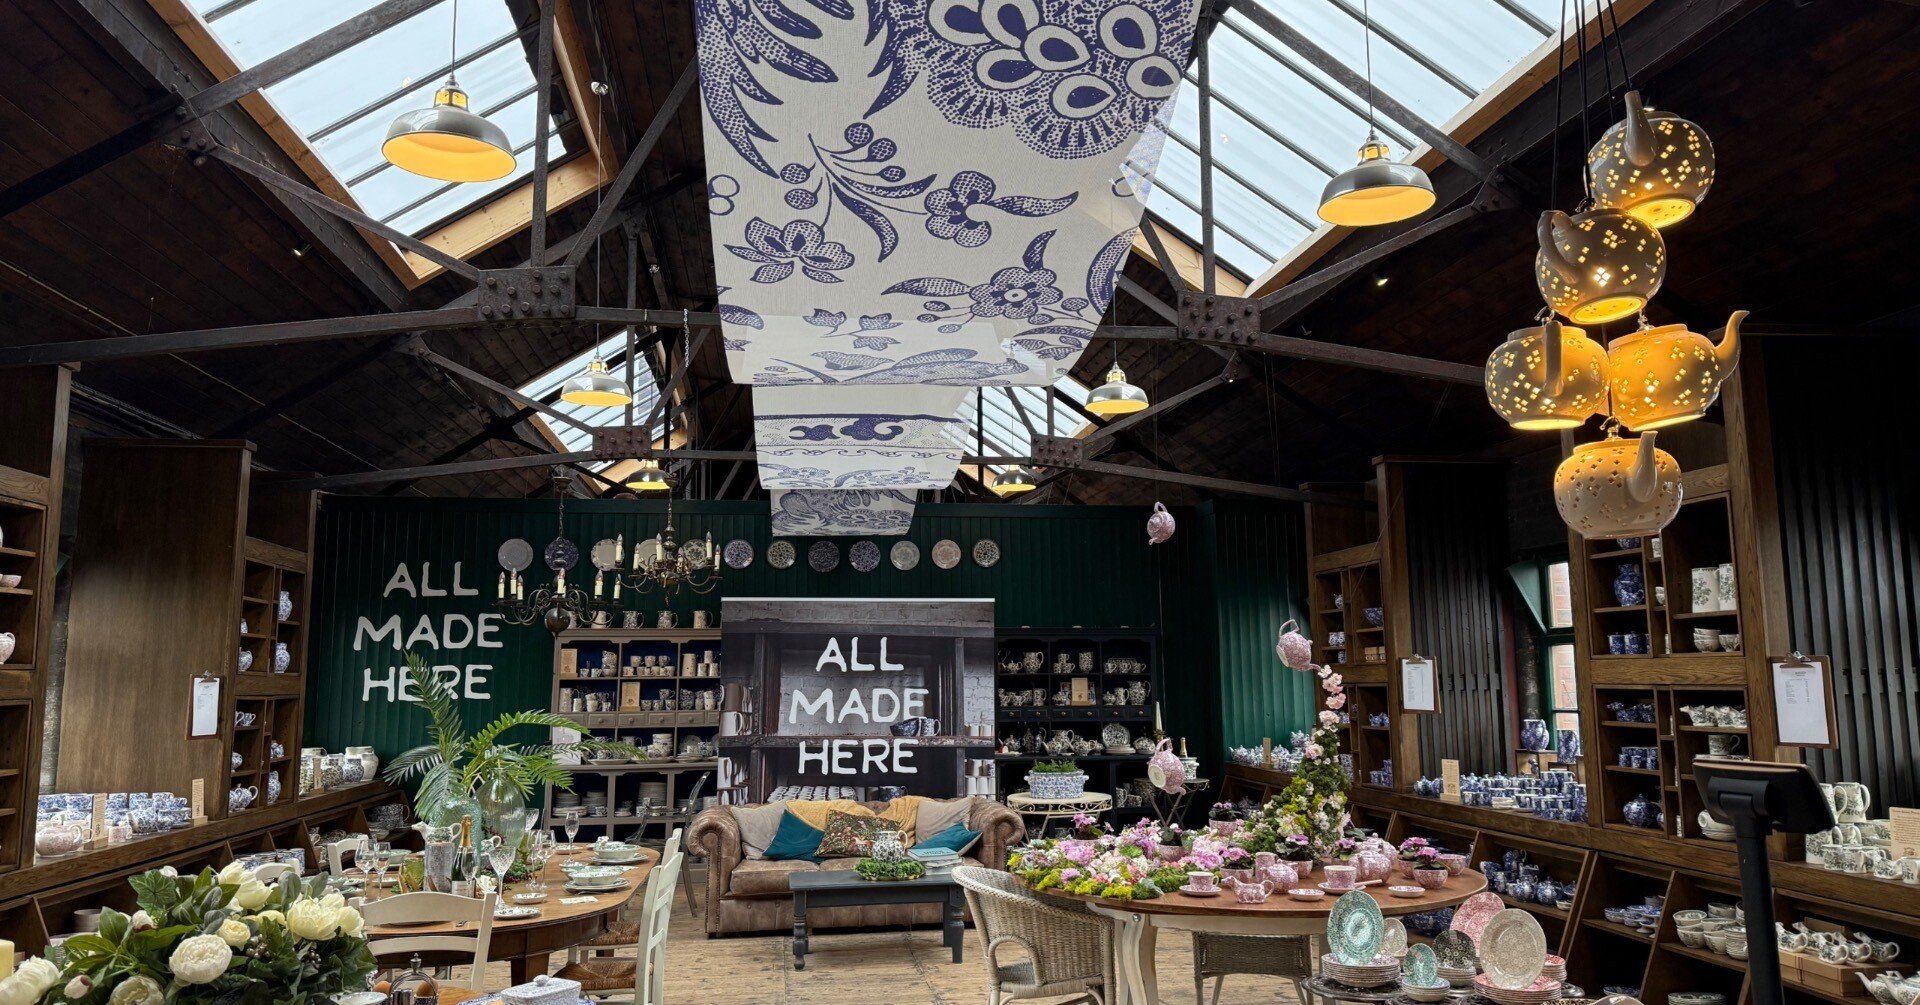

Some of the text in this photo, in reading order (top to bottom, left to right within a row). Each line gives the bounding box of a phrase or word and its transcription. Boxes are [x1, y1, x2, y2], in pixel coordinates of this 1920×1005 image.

[383, 561, 479, 598] ALL
[353, 613, 506, 651] MADE
[816, 636, 904, 673] ALL
[362, 664, 493, 703] HERE
[789, 688, 929, 724] MADE
[798, 738, 919, 775] HERE
